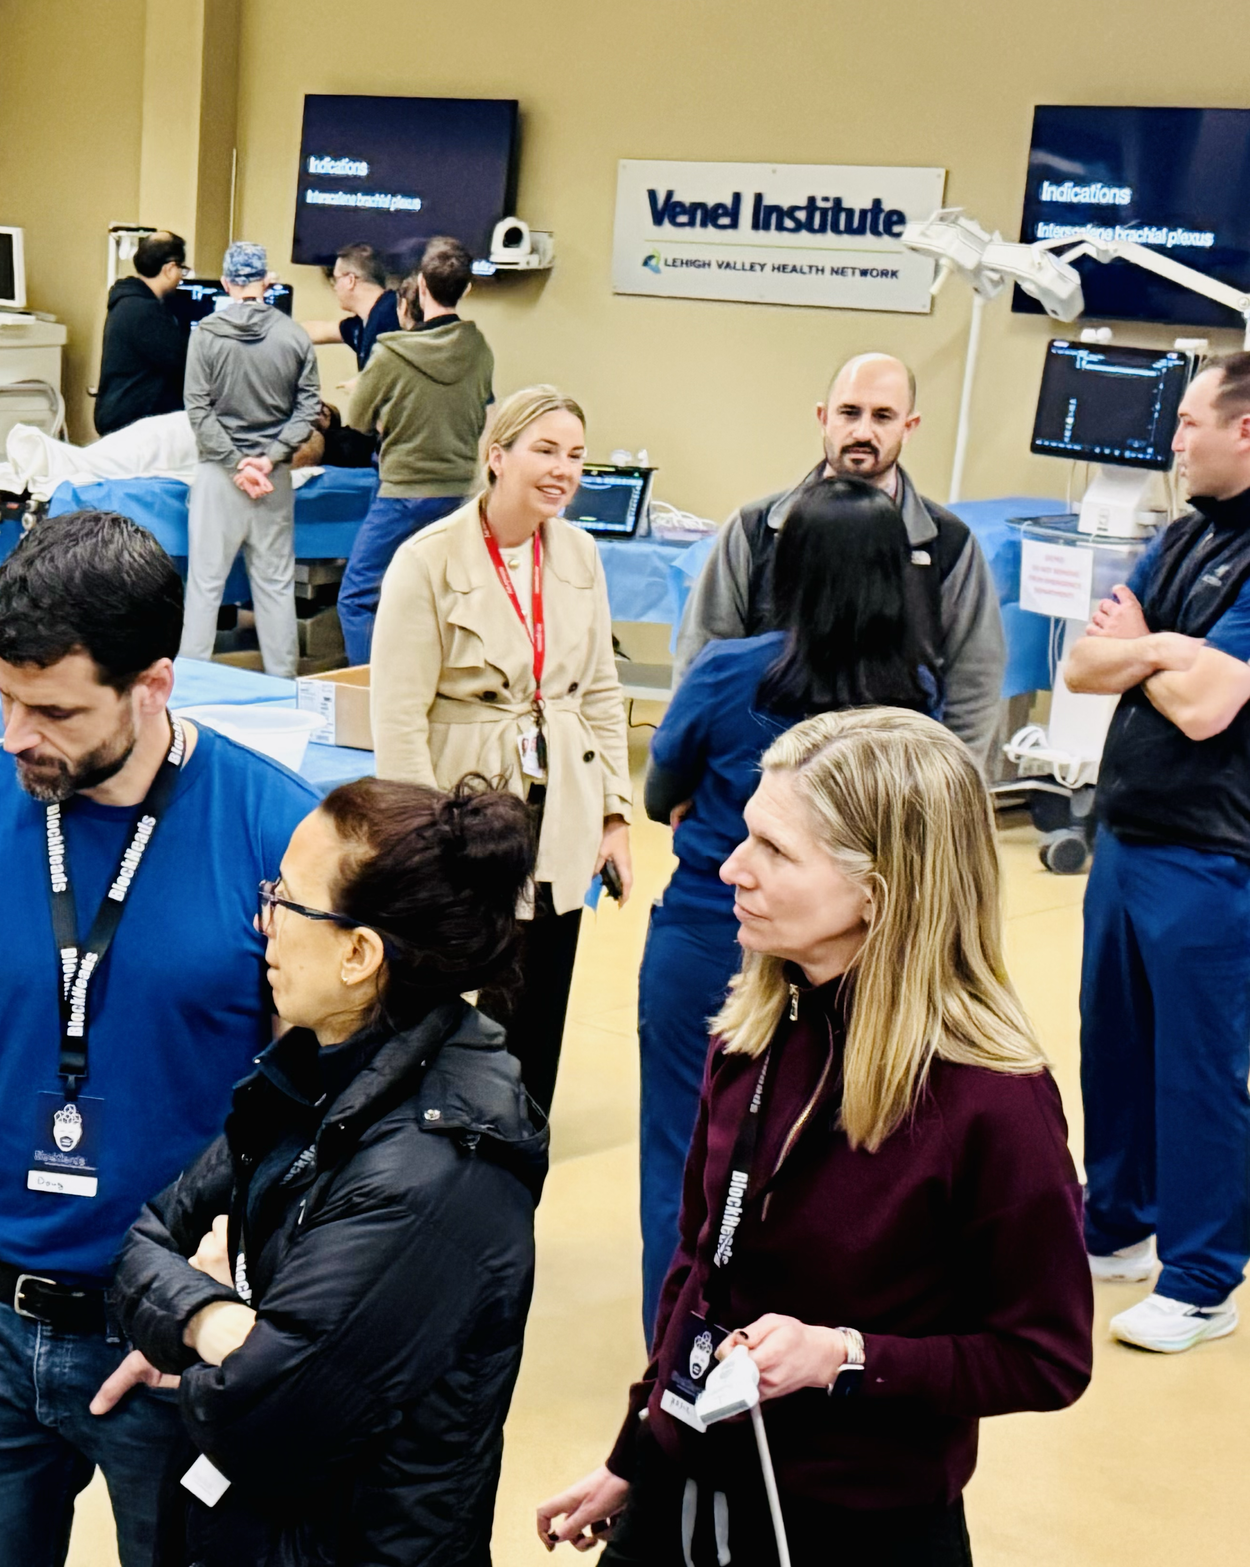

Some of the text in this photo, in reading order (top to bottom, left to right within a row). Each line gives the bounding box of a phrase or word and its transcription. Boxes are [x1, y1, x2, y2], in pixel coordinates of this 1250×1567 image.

[647, 188, 906, 238] Venel Institute
[1041, 180, 1132, 205] Indications
[1166, 228, 1215, 248] plexus
[664, 258, 900, 280] LEHIGH VALLEY HEALTH NETWORK
[46, 803, 68, 892] BlockHeads
[108, 815, 156, 902] BlockHeads
[67, 952, 98, 1037] BlockHeads
